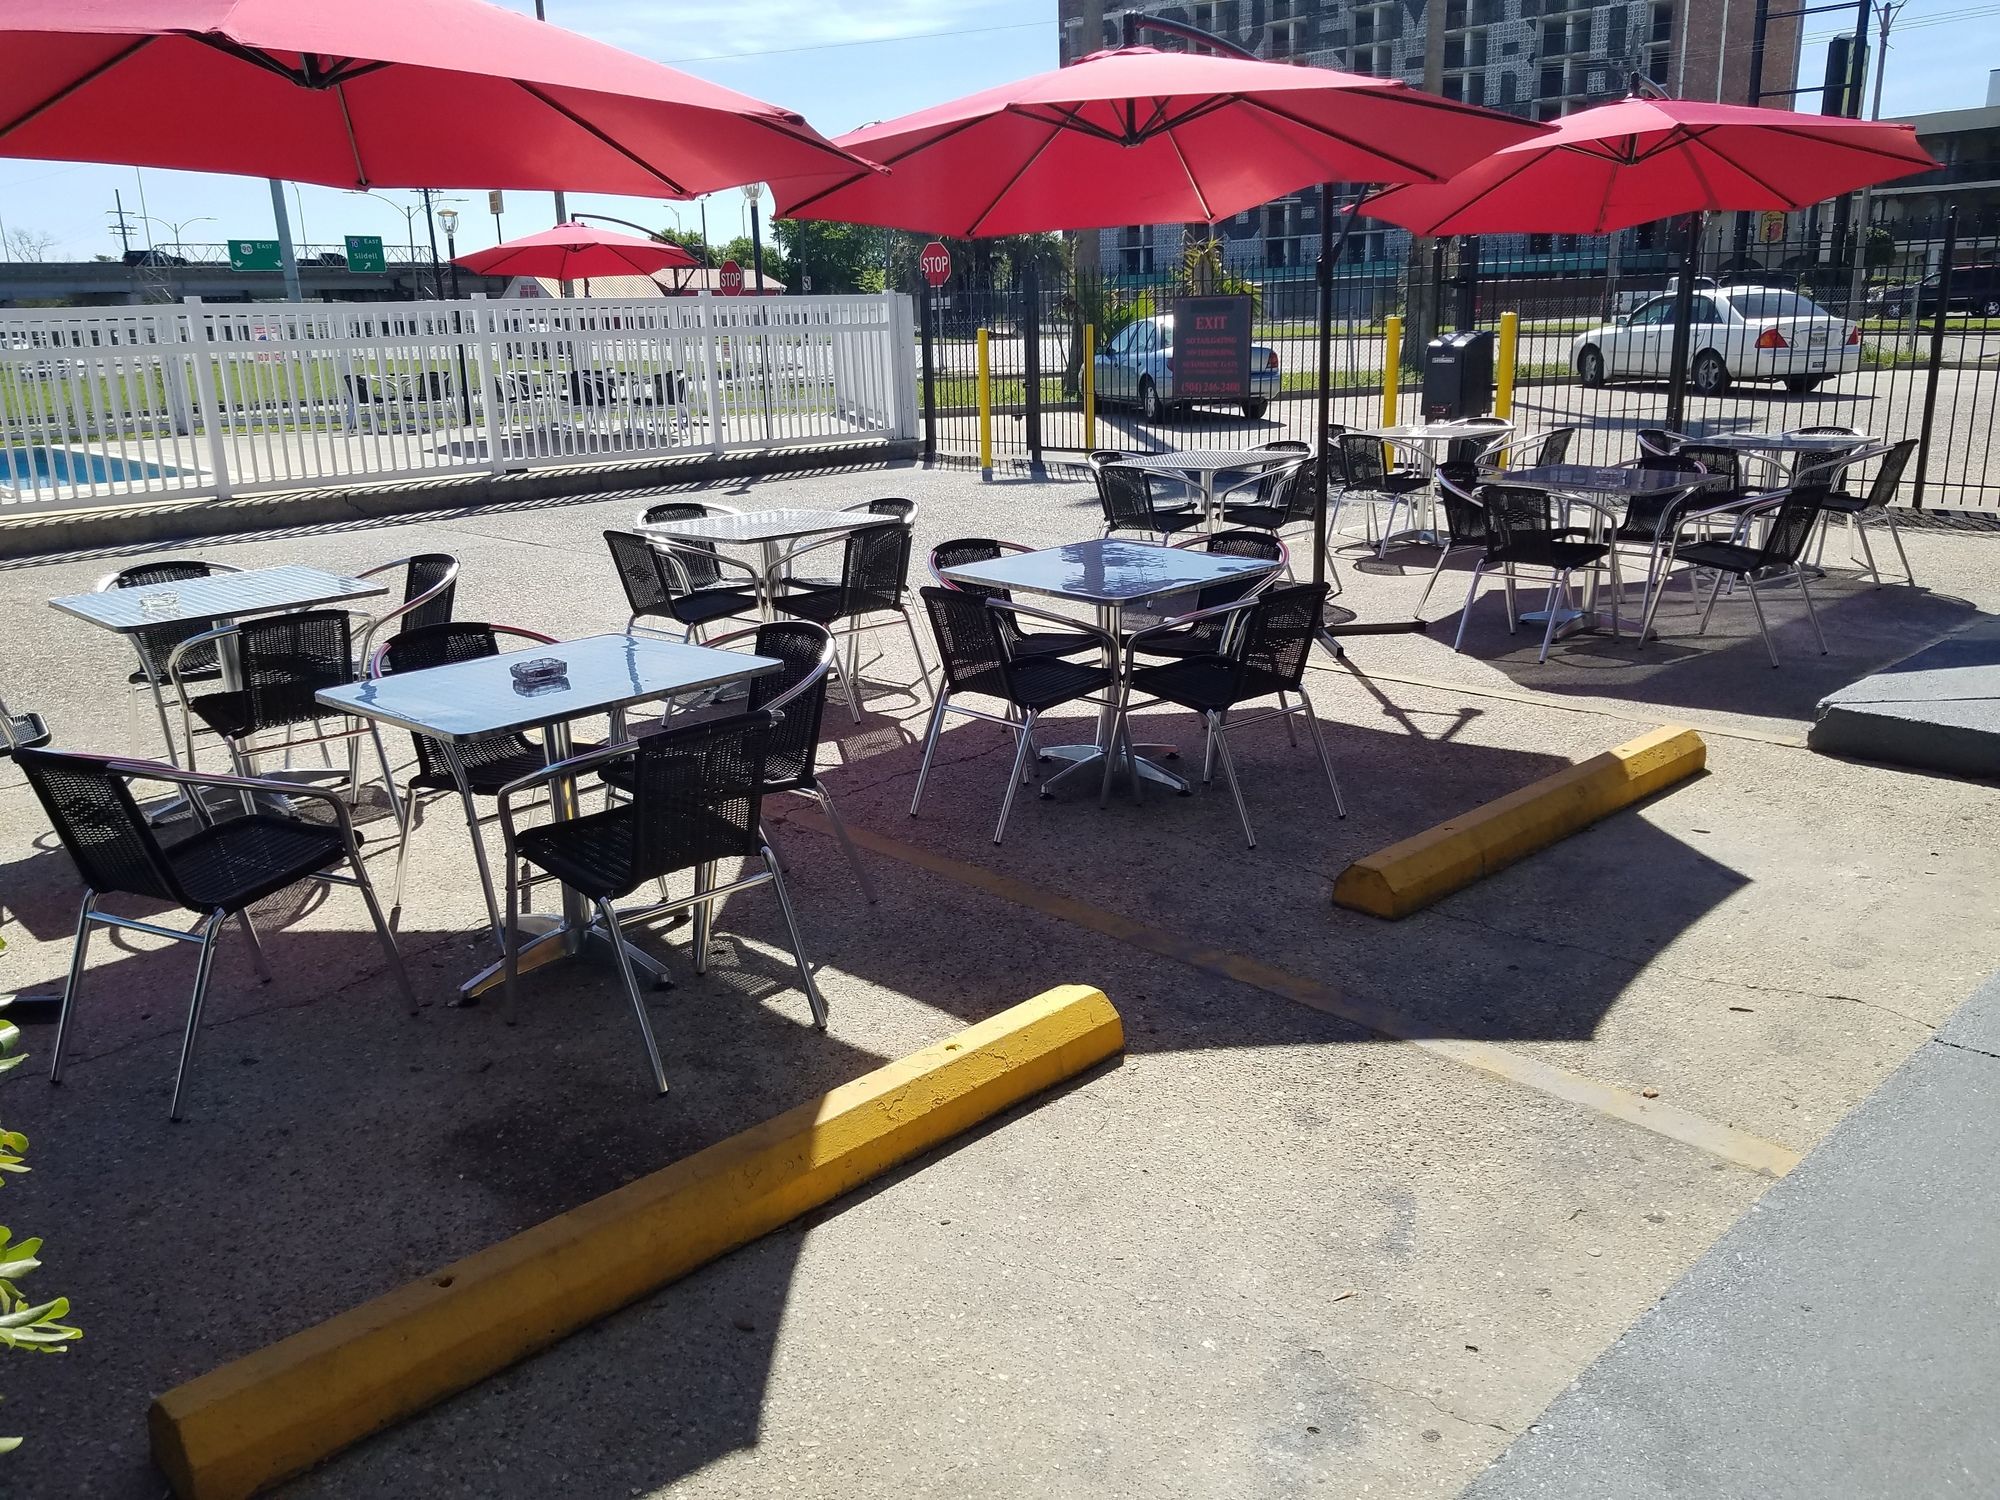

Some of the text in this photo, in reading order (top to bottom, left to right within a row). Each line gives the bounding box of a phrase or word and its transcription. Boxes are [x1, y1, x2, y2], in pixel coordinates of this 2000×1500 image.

[353, 252, 378, 260] Slidell
[922, 256, 949, 273] STOP
[720, 272, 741, 287] STOP
[1195, 315, 1228, 330] EXIT
